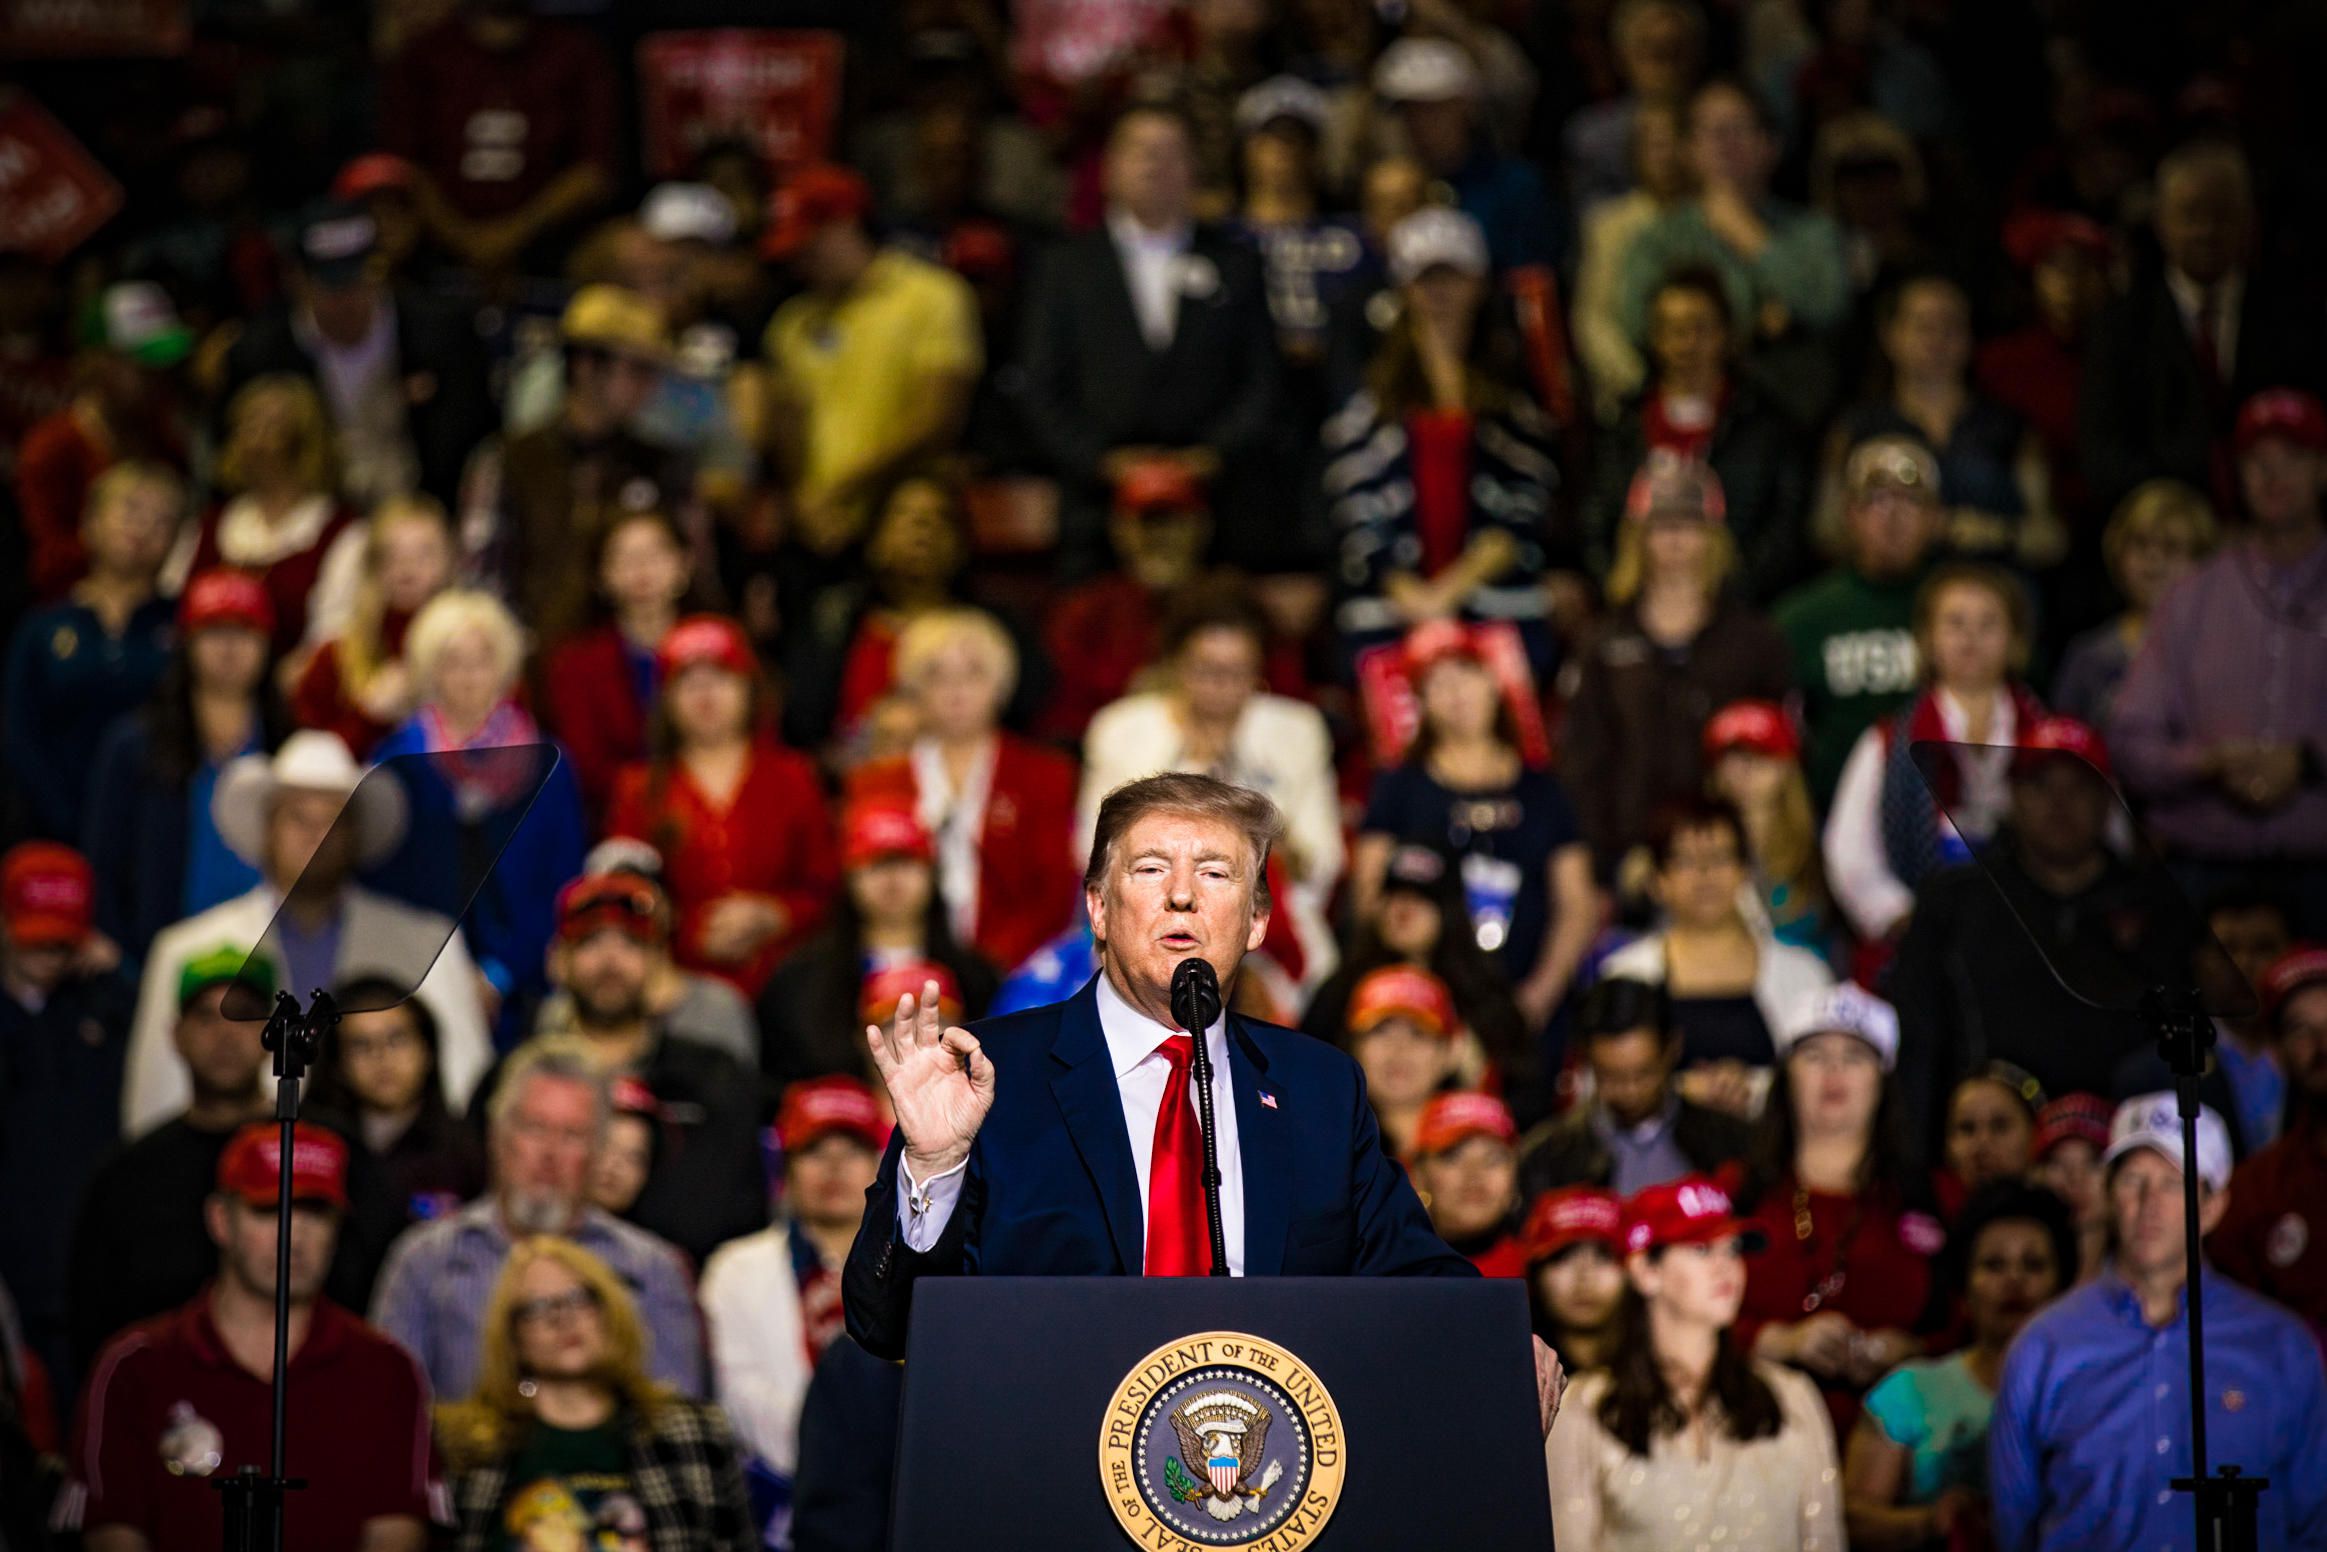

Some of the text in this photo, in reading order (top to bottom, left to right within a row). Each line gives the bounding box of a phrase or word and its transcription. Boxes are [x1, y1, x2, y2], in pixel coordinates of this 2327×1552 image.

[1222, 1344, 1243, 1358] OF
[1249, 1348, 1279, 1371] THE
[1108, 1342, 1213, 1450] PRESIDENT
[1285, 1368, 1337, 1467] UNITED
[1112, 1460, 1130, 1494] THE
[1121, 1498, 1140, 1517] OF
